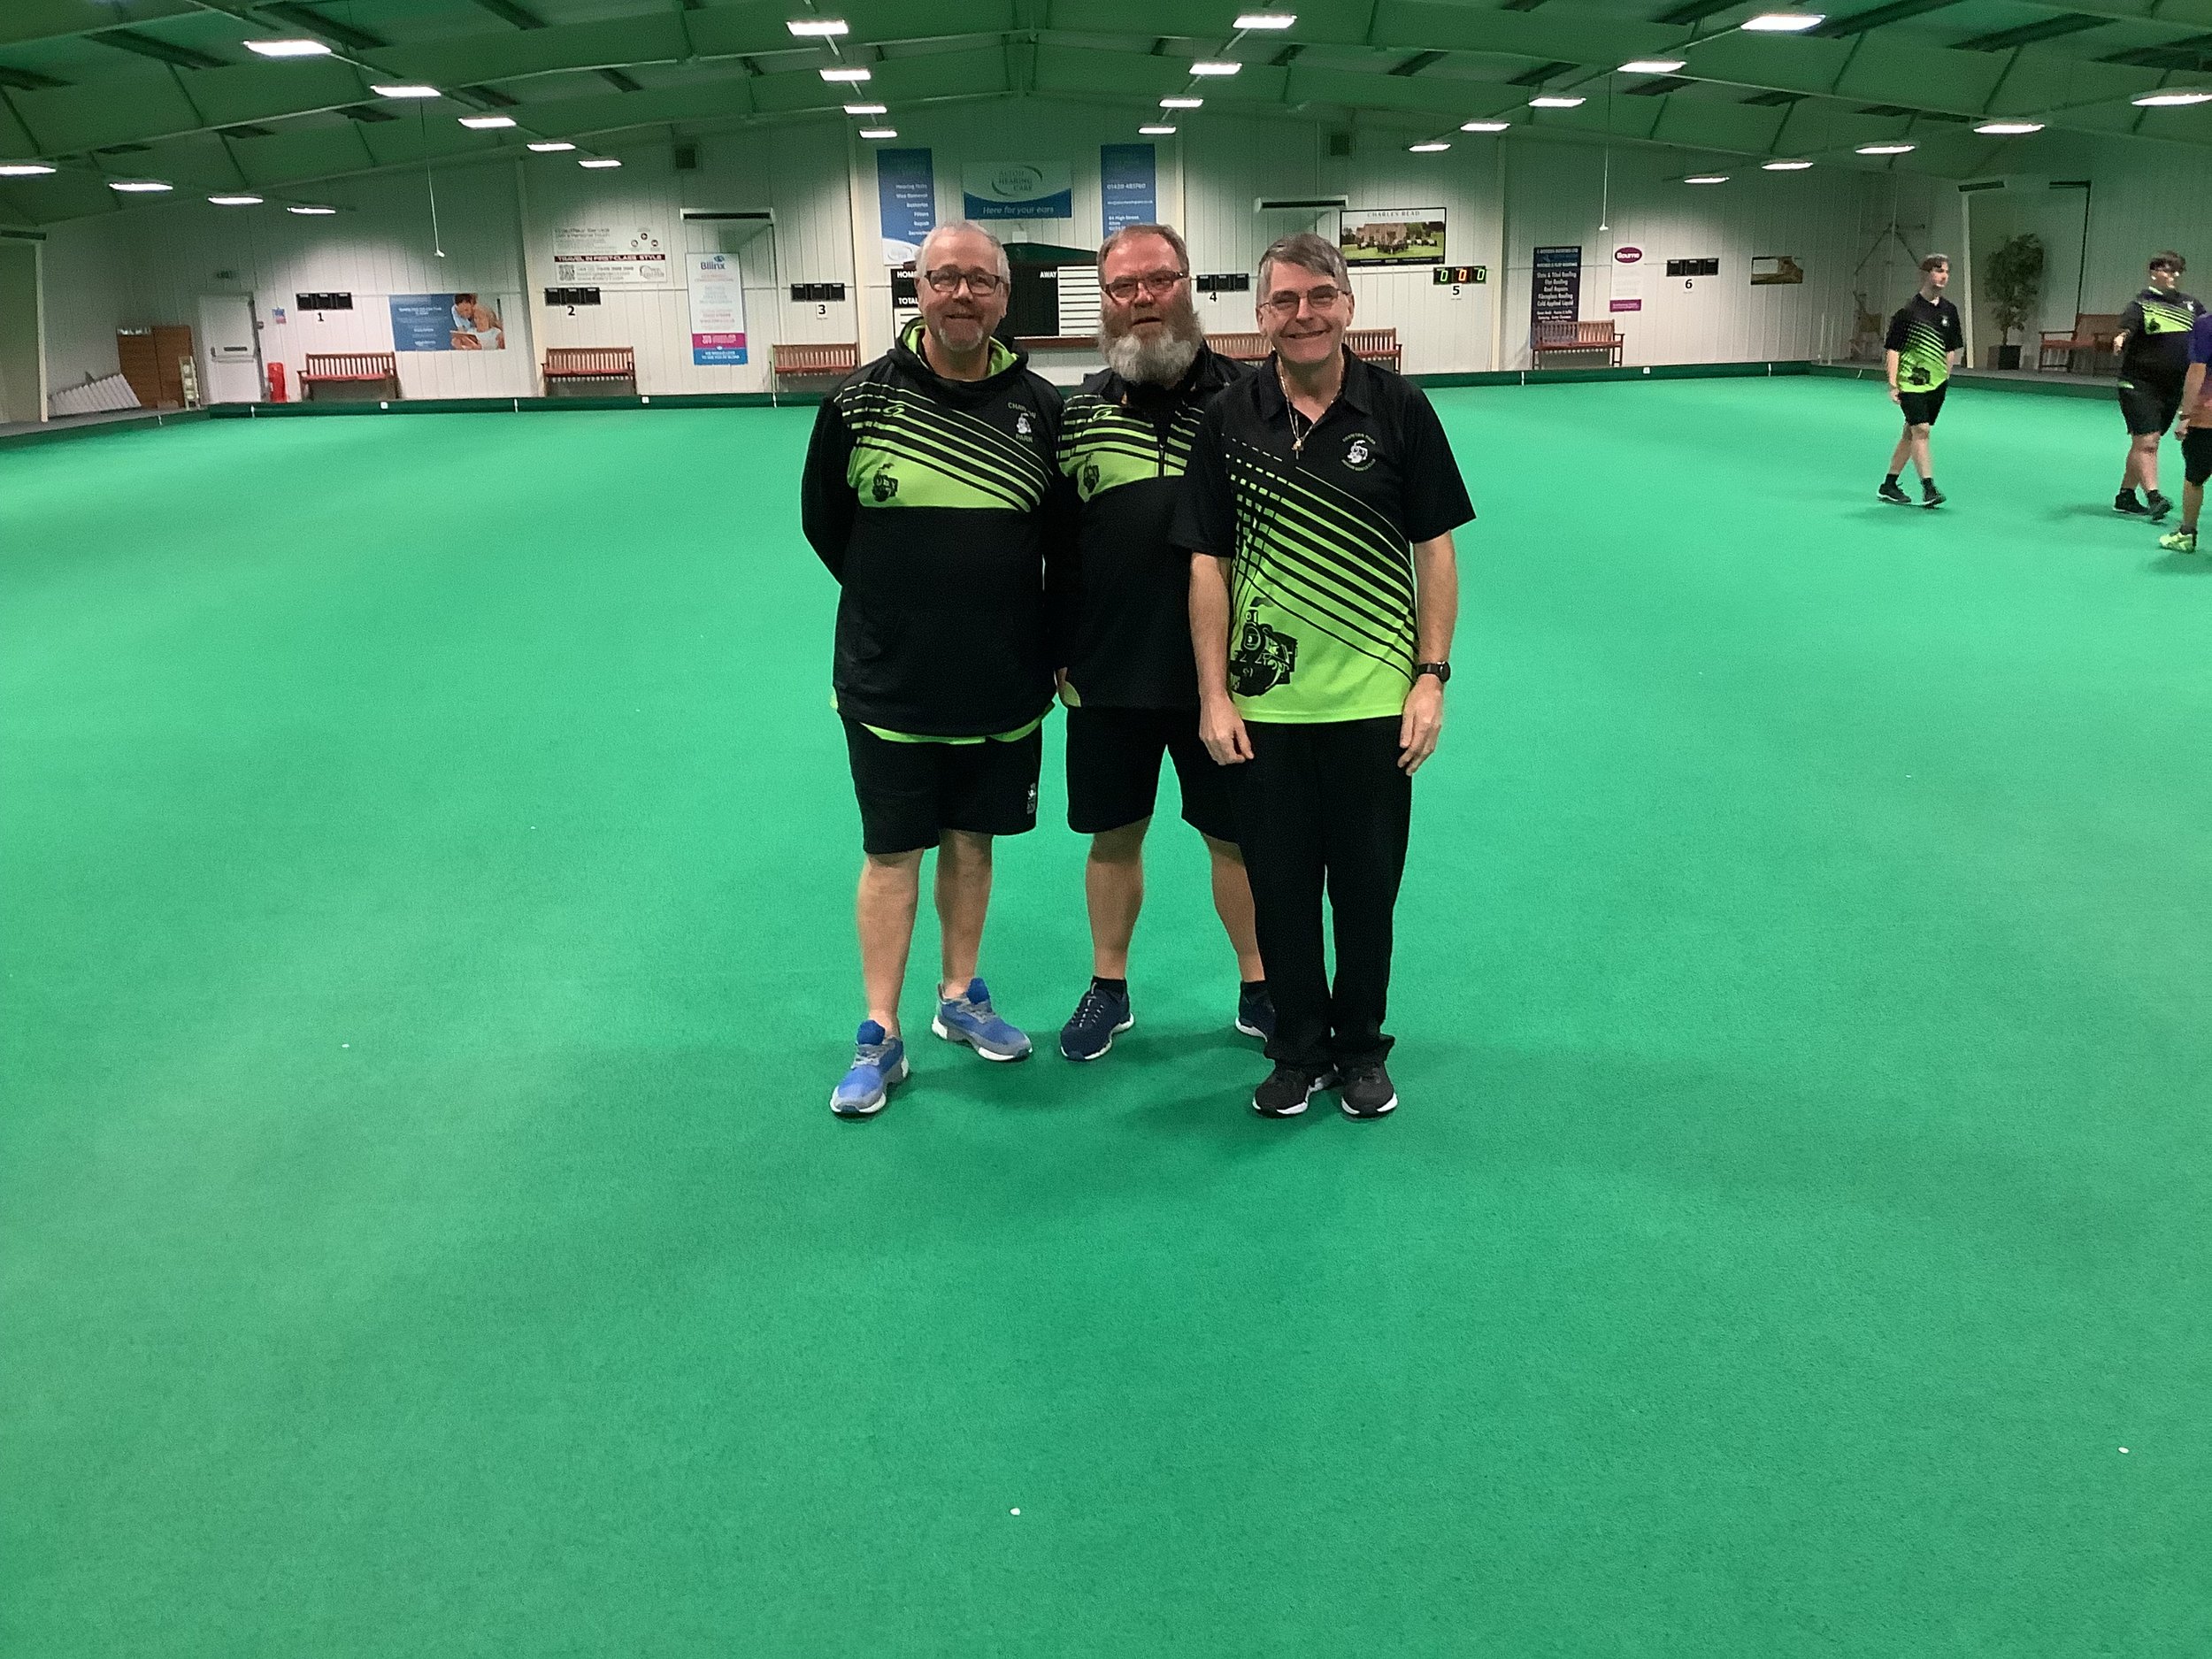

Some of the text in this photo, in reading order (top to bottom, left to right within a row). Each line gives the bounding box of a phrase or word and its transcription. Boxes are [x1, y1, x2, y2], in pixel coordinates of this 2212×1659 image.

[982, 206, 1002, 215] Here
[1003, 205, 1015, 214] for
[1017, 206, 1034, 216] your
[1440, 270, 1448, 281] 0
[1458, 269, 1467, 281] 0
[1477, 268, 1486, 280] 0
[1685, 279, 1693, 289] 6
[1452, 285, 1460, 296] 5
[1210, 292, 1217, 303] 4
[567, 305, 576, 316] 2
[818, 304, 826, 315] 3
[317, 312, 324, 322] 1
